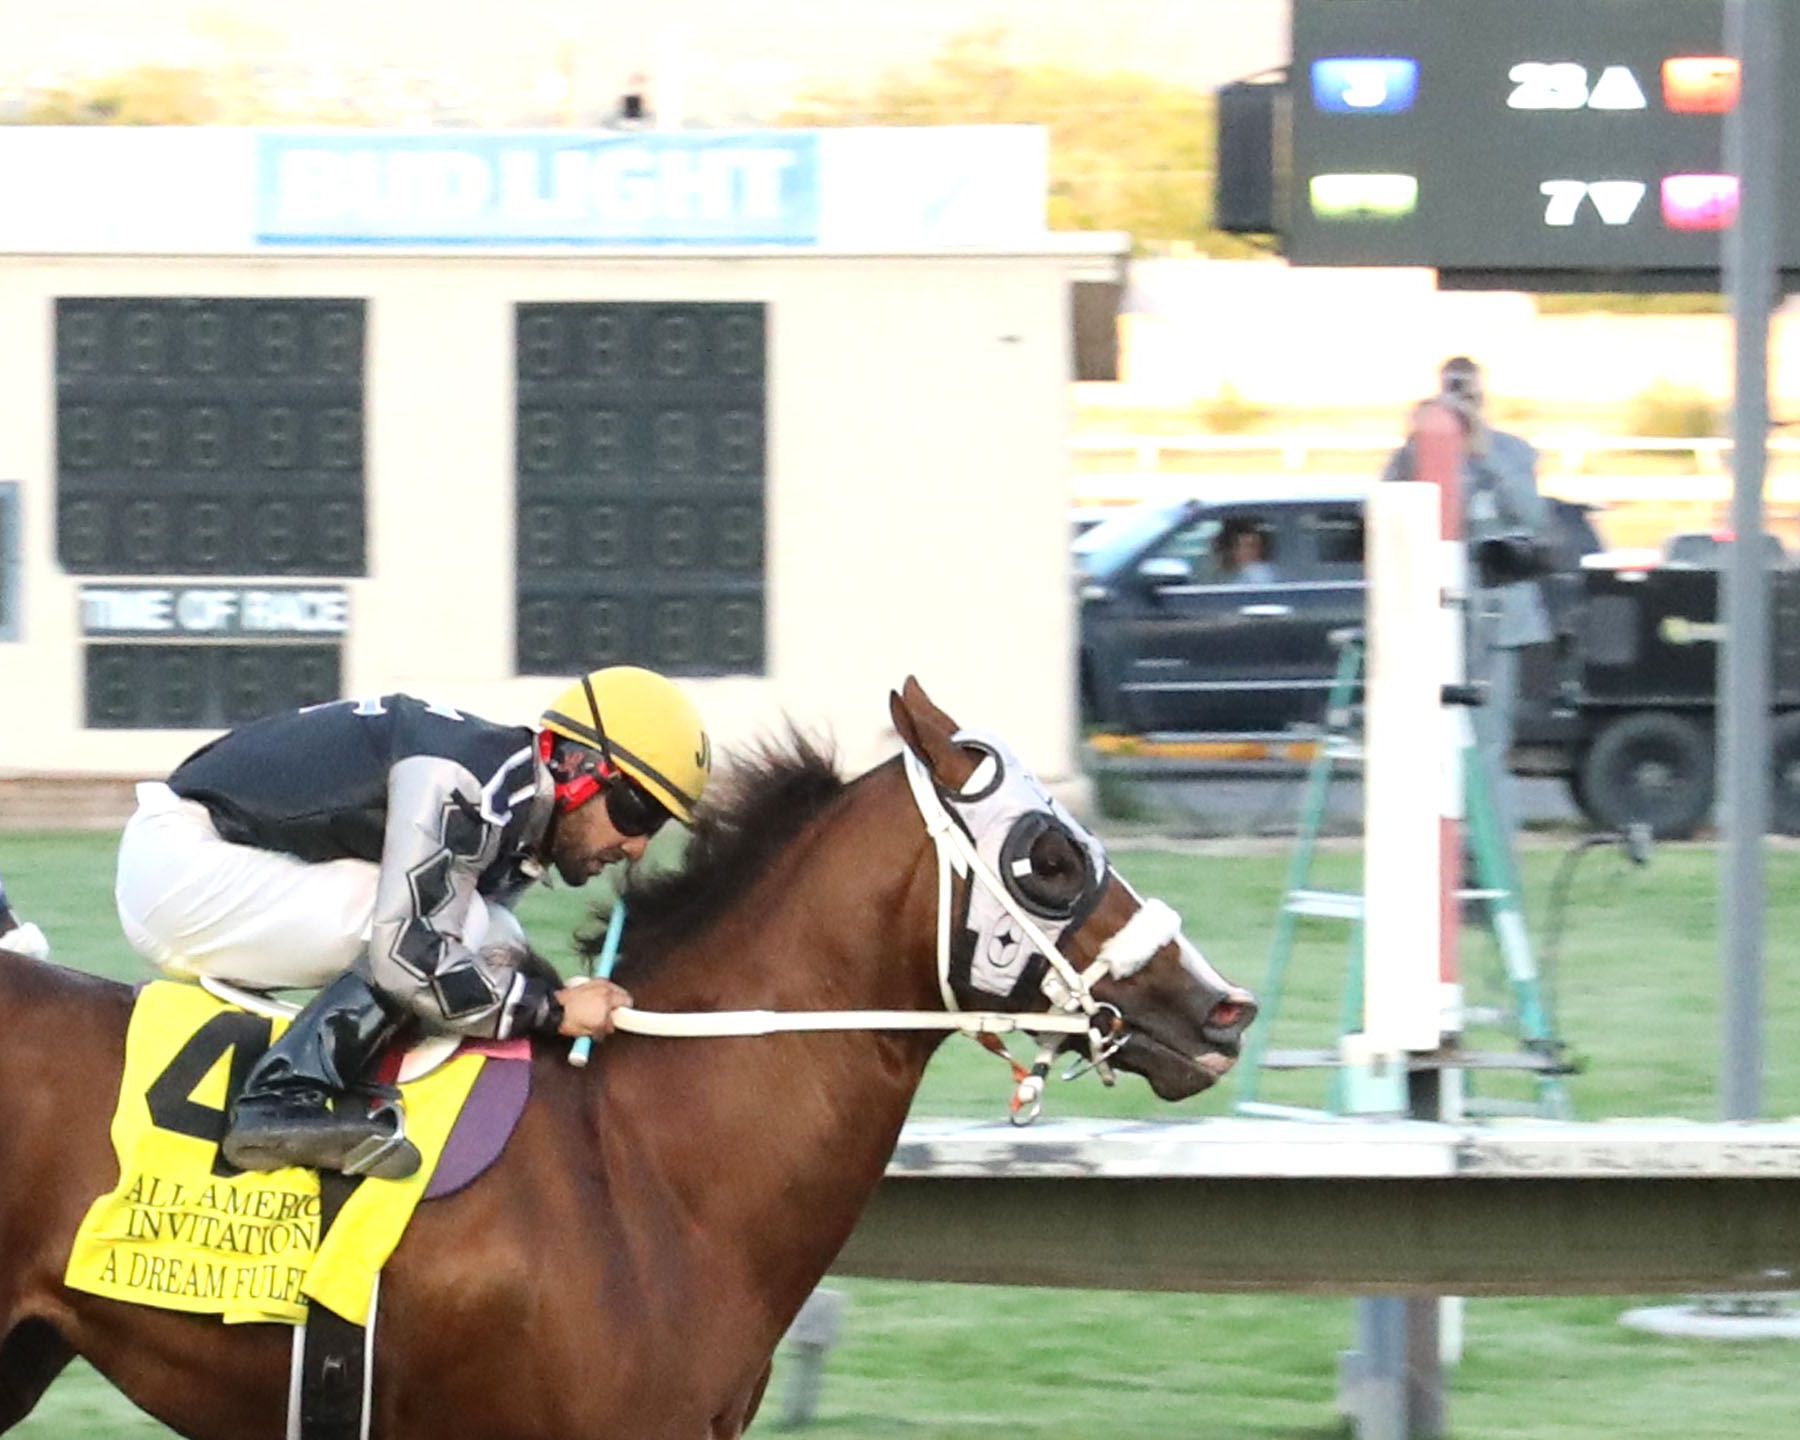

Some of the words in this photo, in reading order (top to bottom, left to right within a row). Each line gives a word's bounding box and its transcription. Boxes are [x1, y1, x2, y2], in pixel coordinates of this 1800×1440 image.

[281, 150, 487, 217] BUD
[504, 149, 795, 217] LIGHT
[1540, 180, 1588, 226] 7
[80, 590, 174, 630] TIME
[175, 590, 238, 630] OF
[240, 590, 348, 631] RACE
[145, 1010, 273, 1178] 4
[125, 1173, 186, 1207] ALL
[126, 1207, 314, 1256] INVITATION
[100, 1247, 117, 1284] A
[127, 1252, 227, 1299] DREAM
